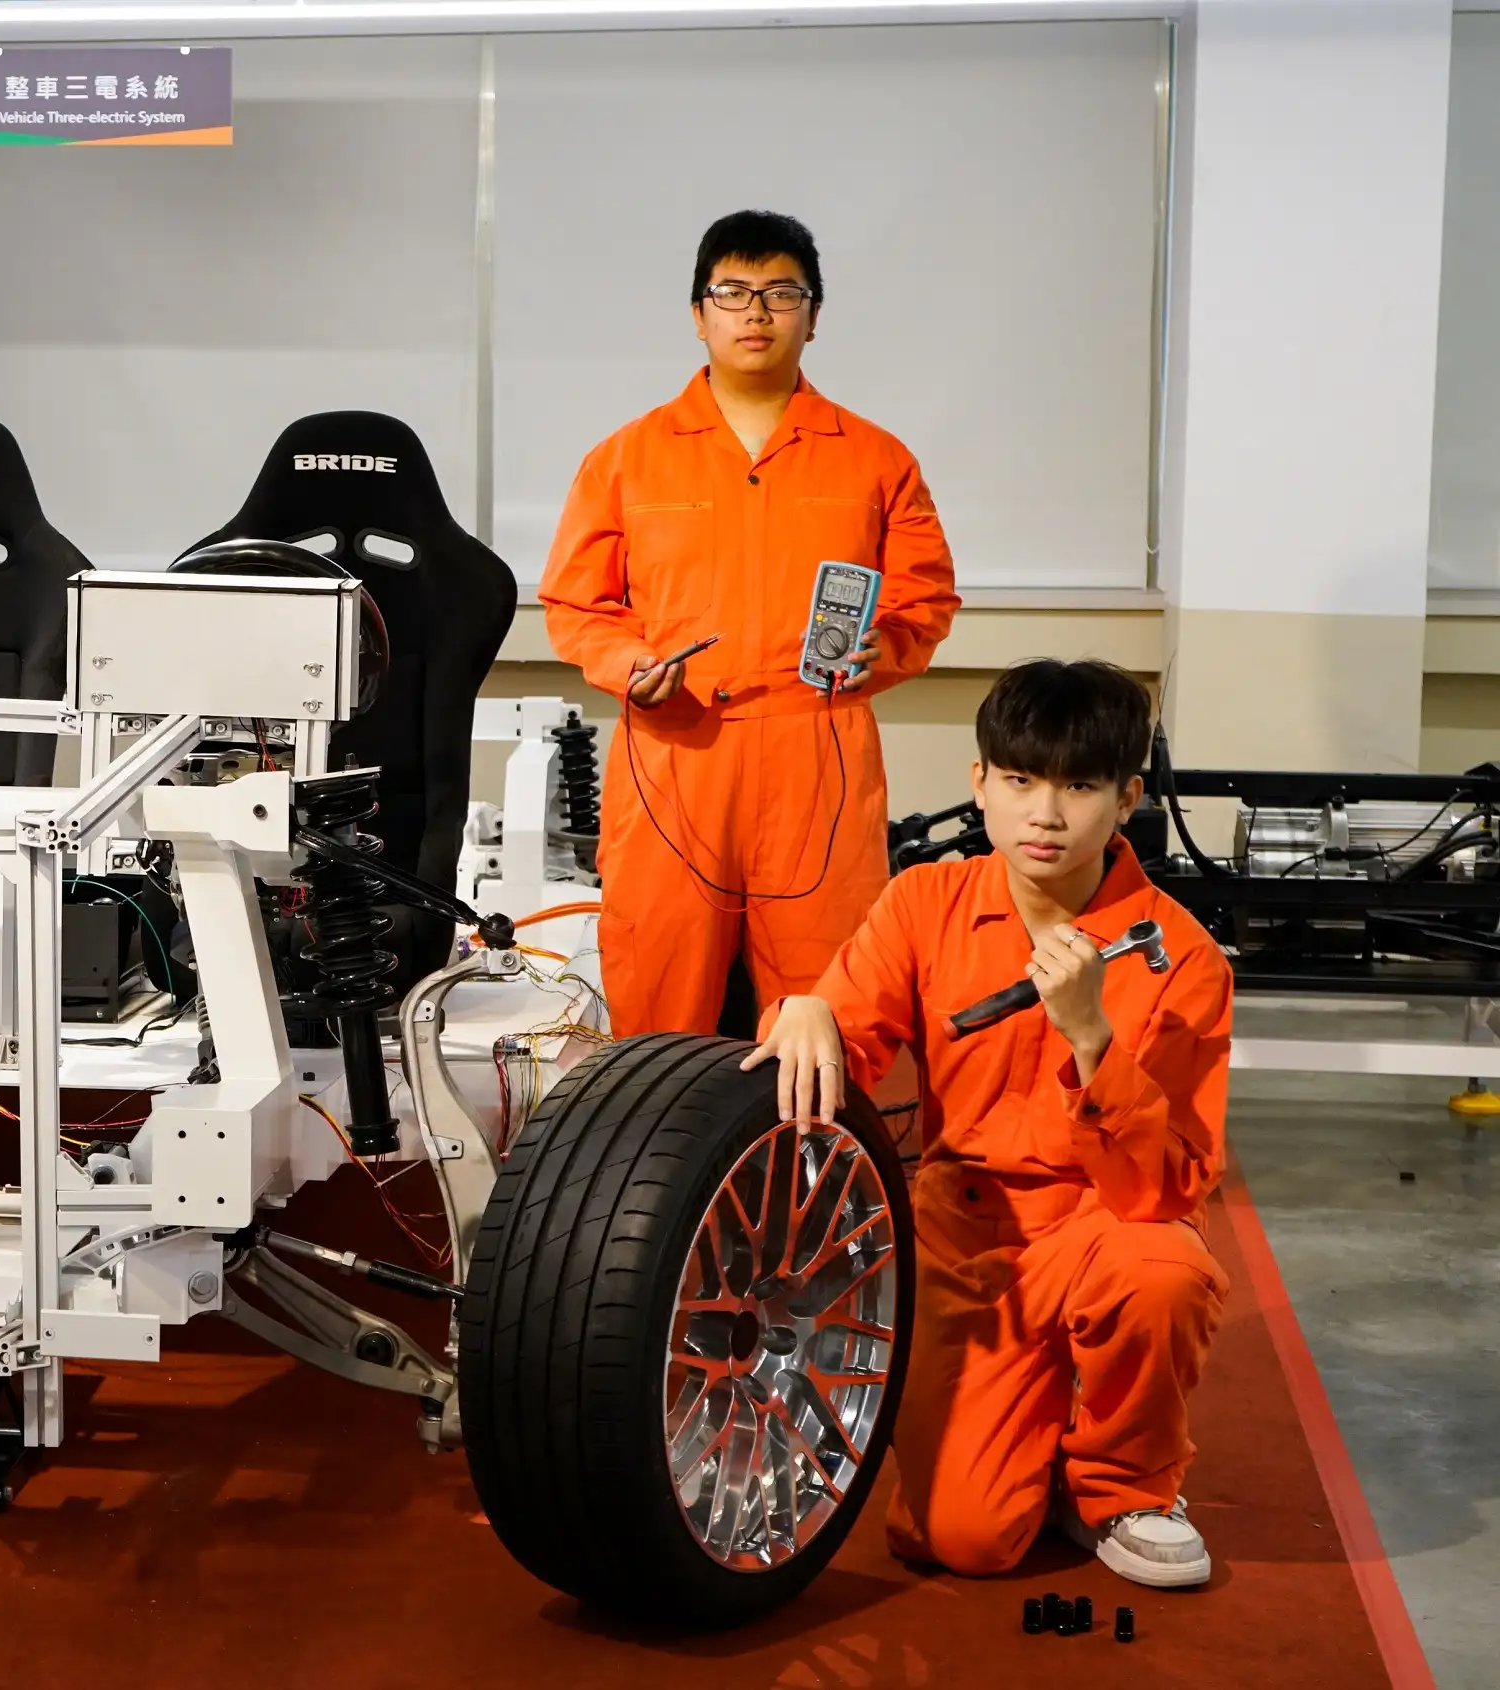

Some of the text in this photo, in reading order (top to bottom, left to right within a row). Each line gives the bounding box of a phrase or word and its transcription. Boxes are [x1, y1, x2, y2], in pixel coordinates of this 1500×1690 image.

[5, 75, 180, 100] 整車三電系統
[47, 111, 137, 124] Three-electric
[138, 111, 186, 127] System
[293, 454, 398, 474] BRIDE
